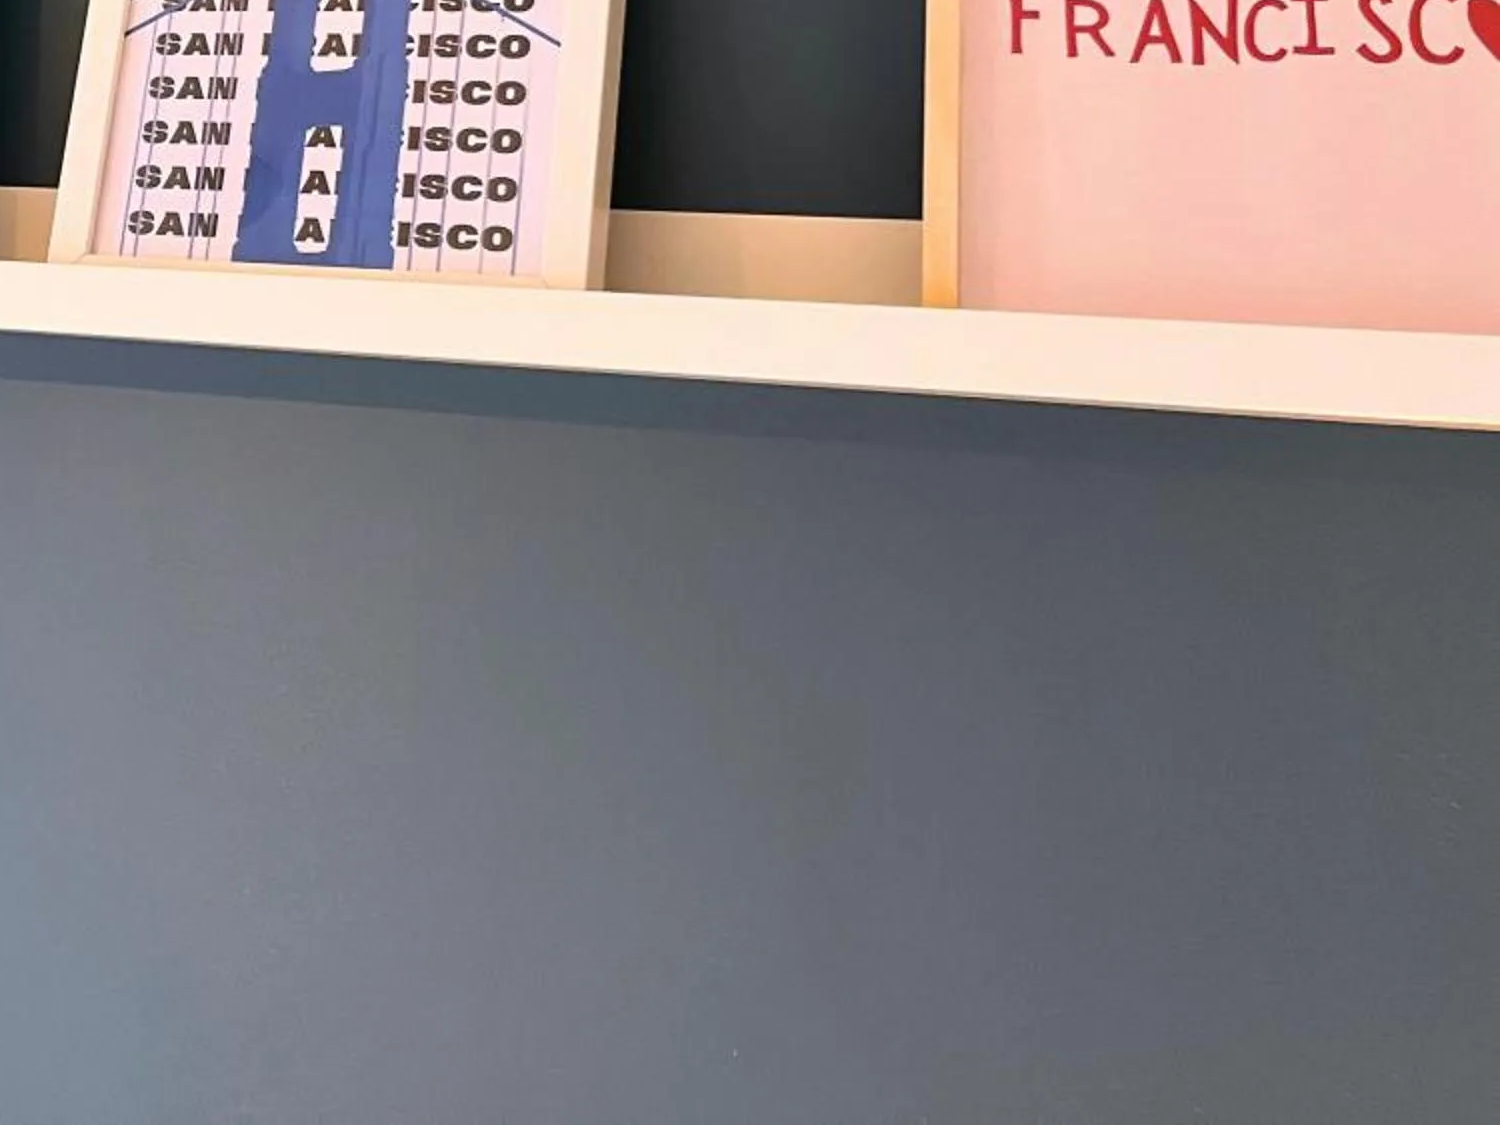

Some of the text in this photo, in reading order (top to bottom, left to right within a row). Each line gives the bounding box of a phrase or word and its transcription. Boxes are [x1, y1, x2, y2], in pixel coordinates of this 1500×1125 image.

[155, 33, 244, 57] SAN
[149, 76, 238, 101] SAN
[142, 120, 231, 146] SAN
[135, 165, 225, 191] SAN
[128, 210, 219, 238] SAN
